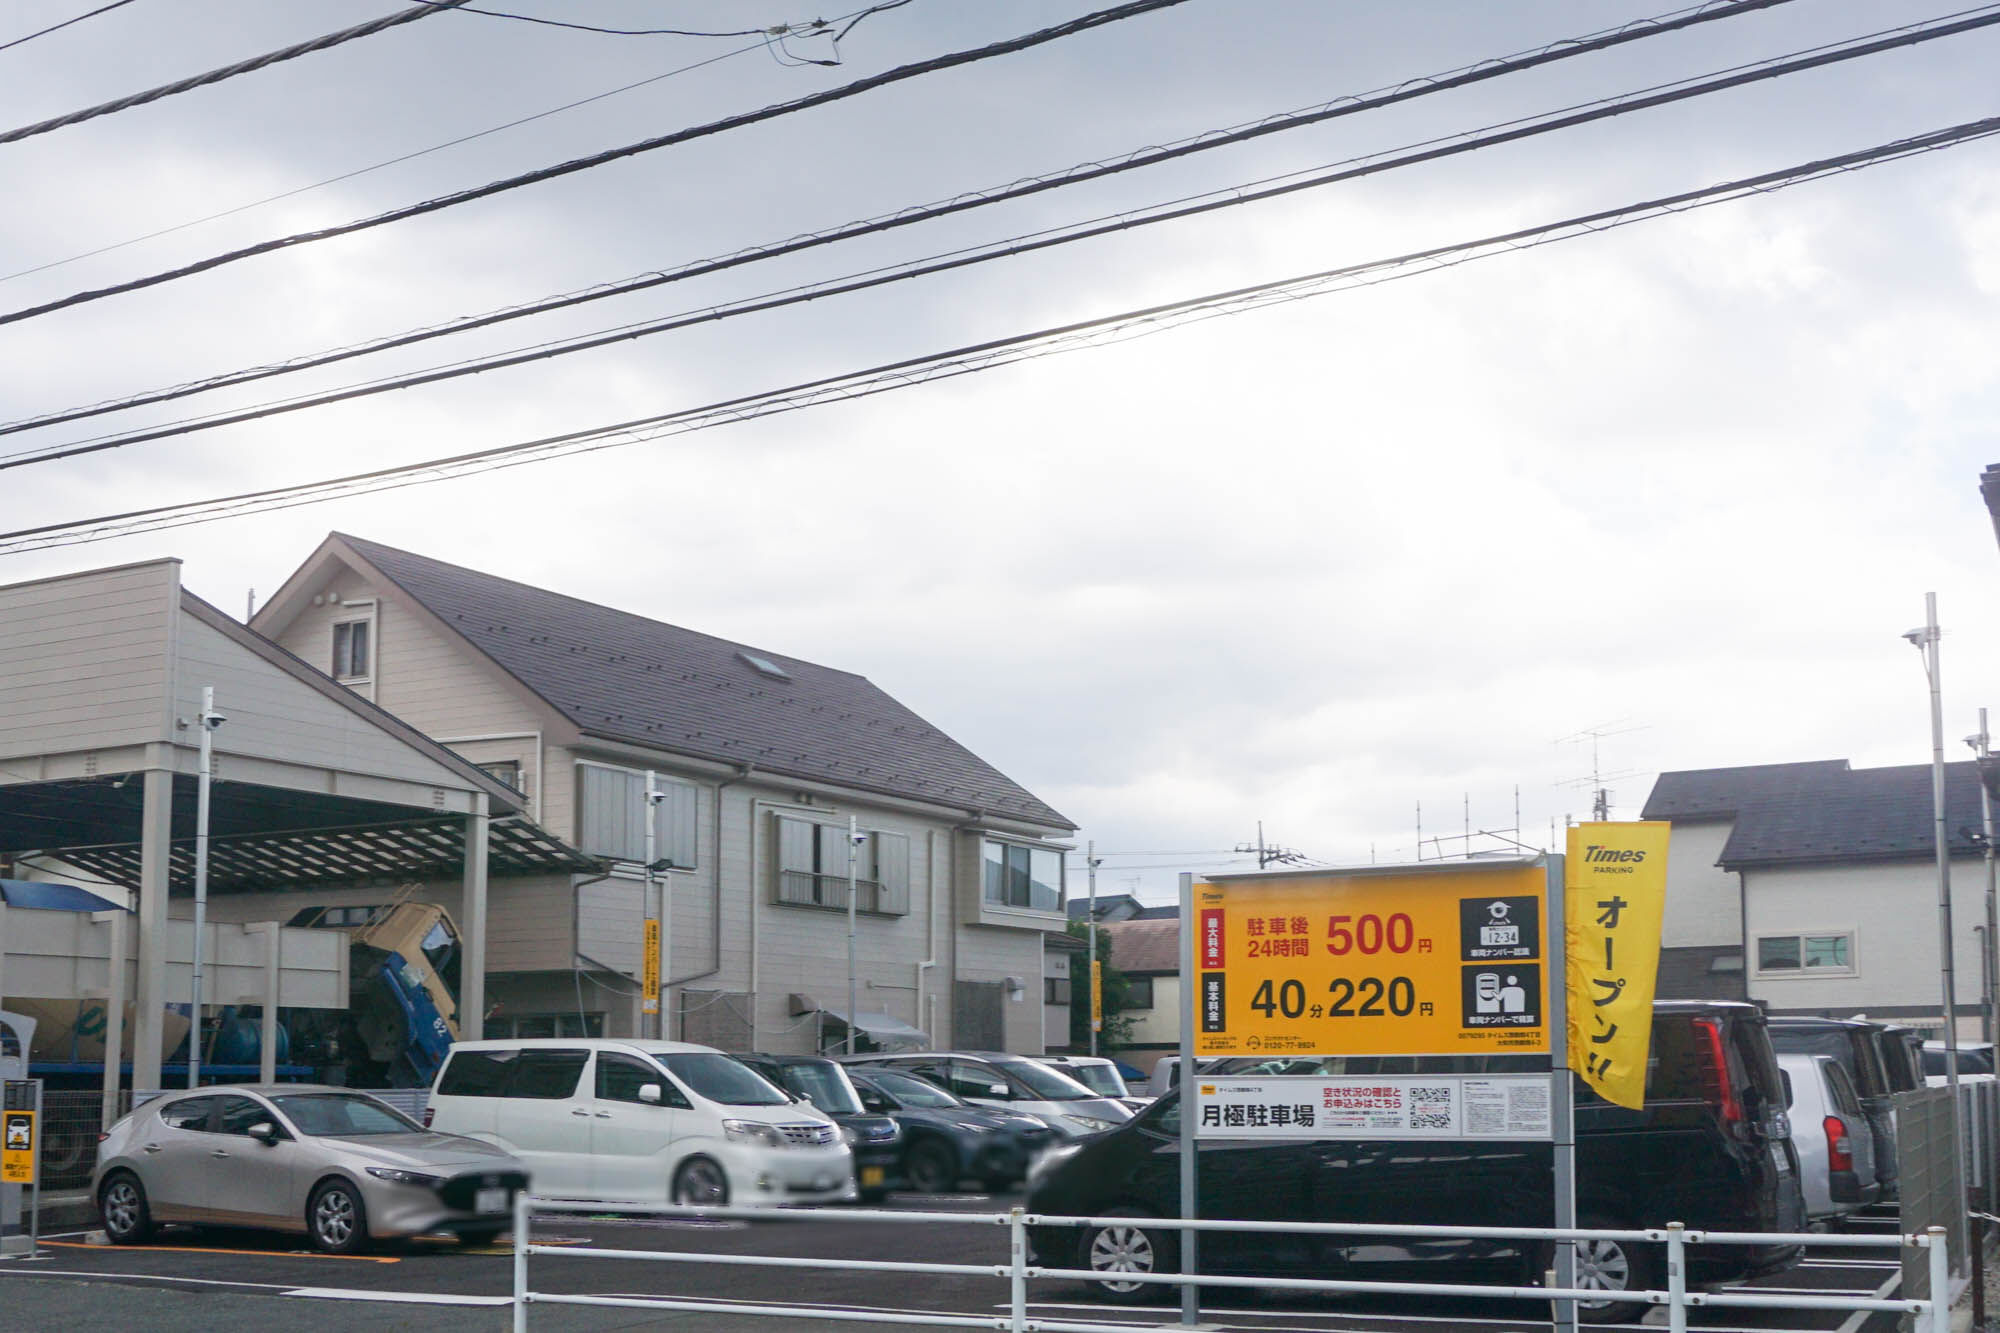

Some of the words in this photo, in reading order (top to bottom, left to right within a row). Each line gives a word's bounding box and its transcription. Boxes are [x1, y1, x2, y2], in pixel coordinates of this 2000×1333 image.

[1585, 845, 1646, 862] Times
[1247, 917, 1309, 936] 駐車後
[1247, 938, 1309, 958] 24時間
[1323, 1087, 1401, 1098] 空き状況の確認と
[1323, 1099, 1402, 1109] お申込みはこちら
[1202, 1104, 1315, 1127] 月極駐車場
